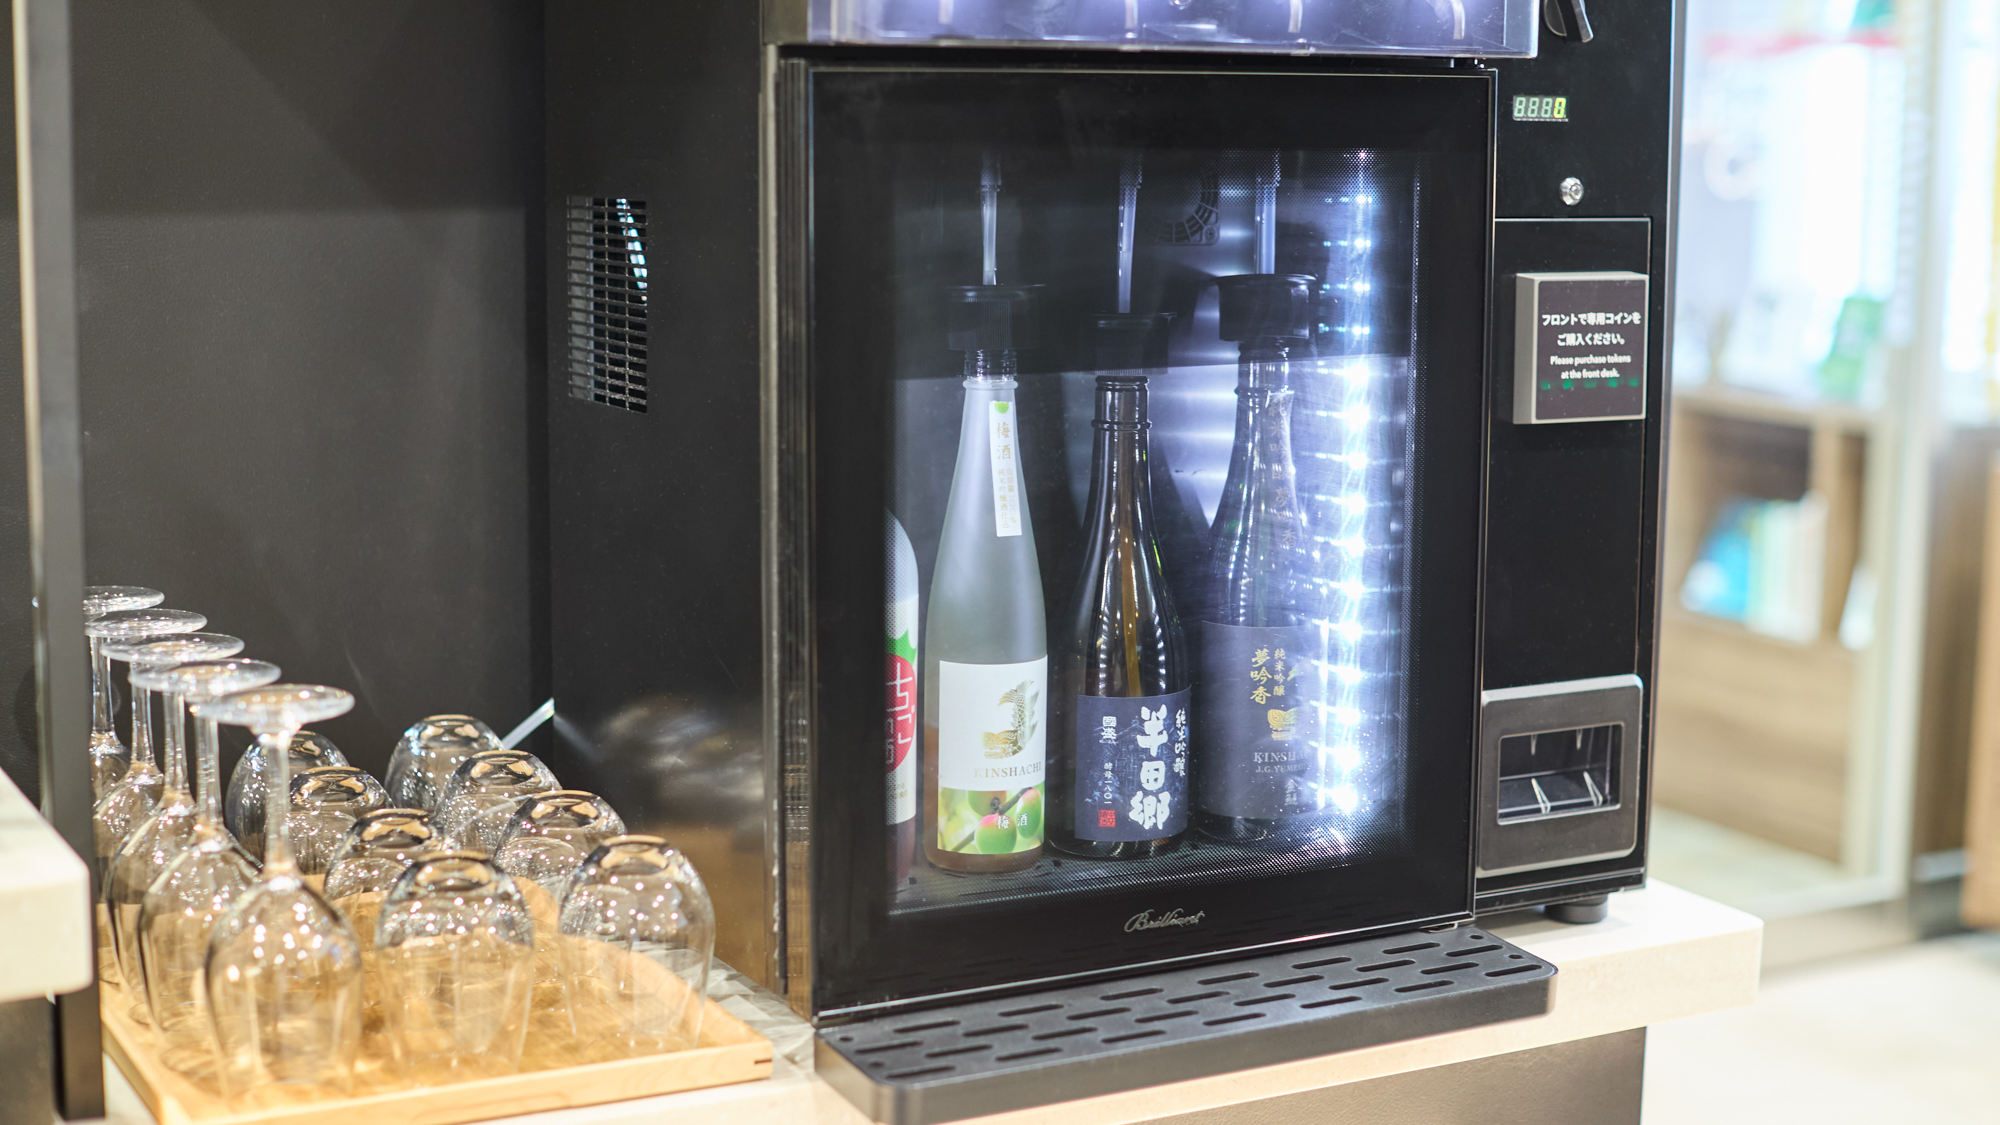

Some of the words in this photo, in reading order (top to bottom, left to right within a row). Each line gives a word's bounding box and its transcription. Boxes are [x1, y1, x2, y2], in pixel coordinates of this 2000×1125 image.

[1542, 311, 1641, 326] フロントで専用コインを
[1557, 332, 1625, 346] ご購入ください。
[1550, 355, 1574, 365] Please
[1574, 353, 1607, 366] purchase
[1607, 353, 1631, 363] tokens
[1561, 370, 1569, 379] at
[1569, 369, 1582, 379] the
[1582, 368, 1600, 378] front
[1600, 367, 1620, 378] desk.
[996, 422, 1011, 460] 梅酒
[1250, 648, 1272, 704] 夢吟香
[1273, 648, 1286, 696] 純米吟醸
[974, 761, 1042, 778] KINSHACHI
[1128, 704, 1171, 830] 半田郷
[997, 813, 1028, 830] 梅酒
